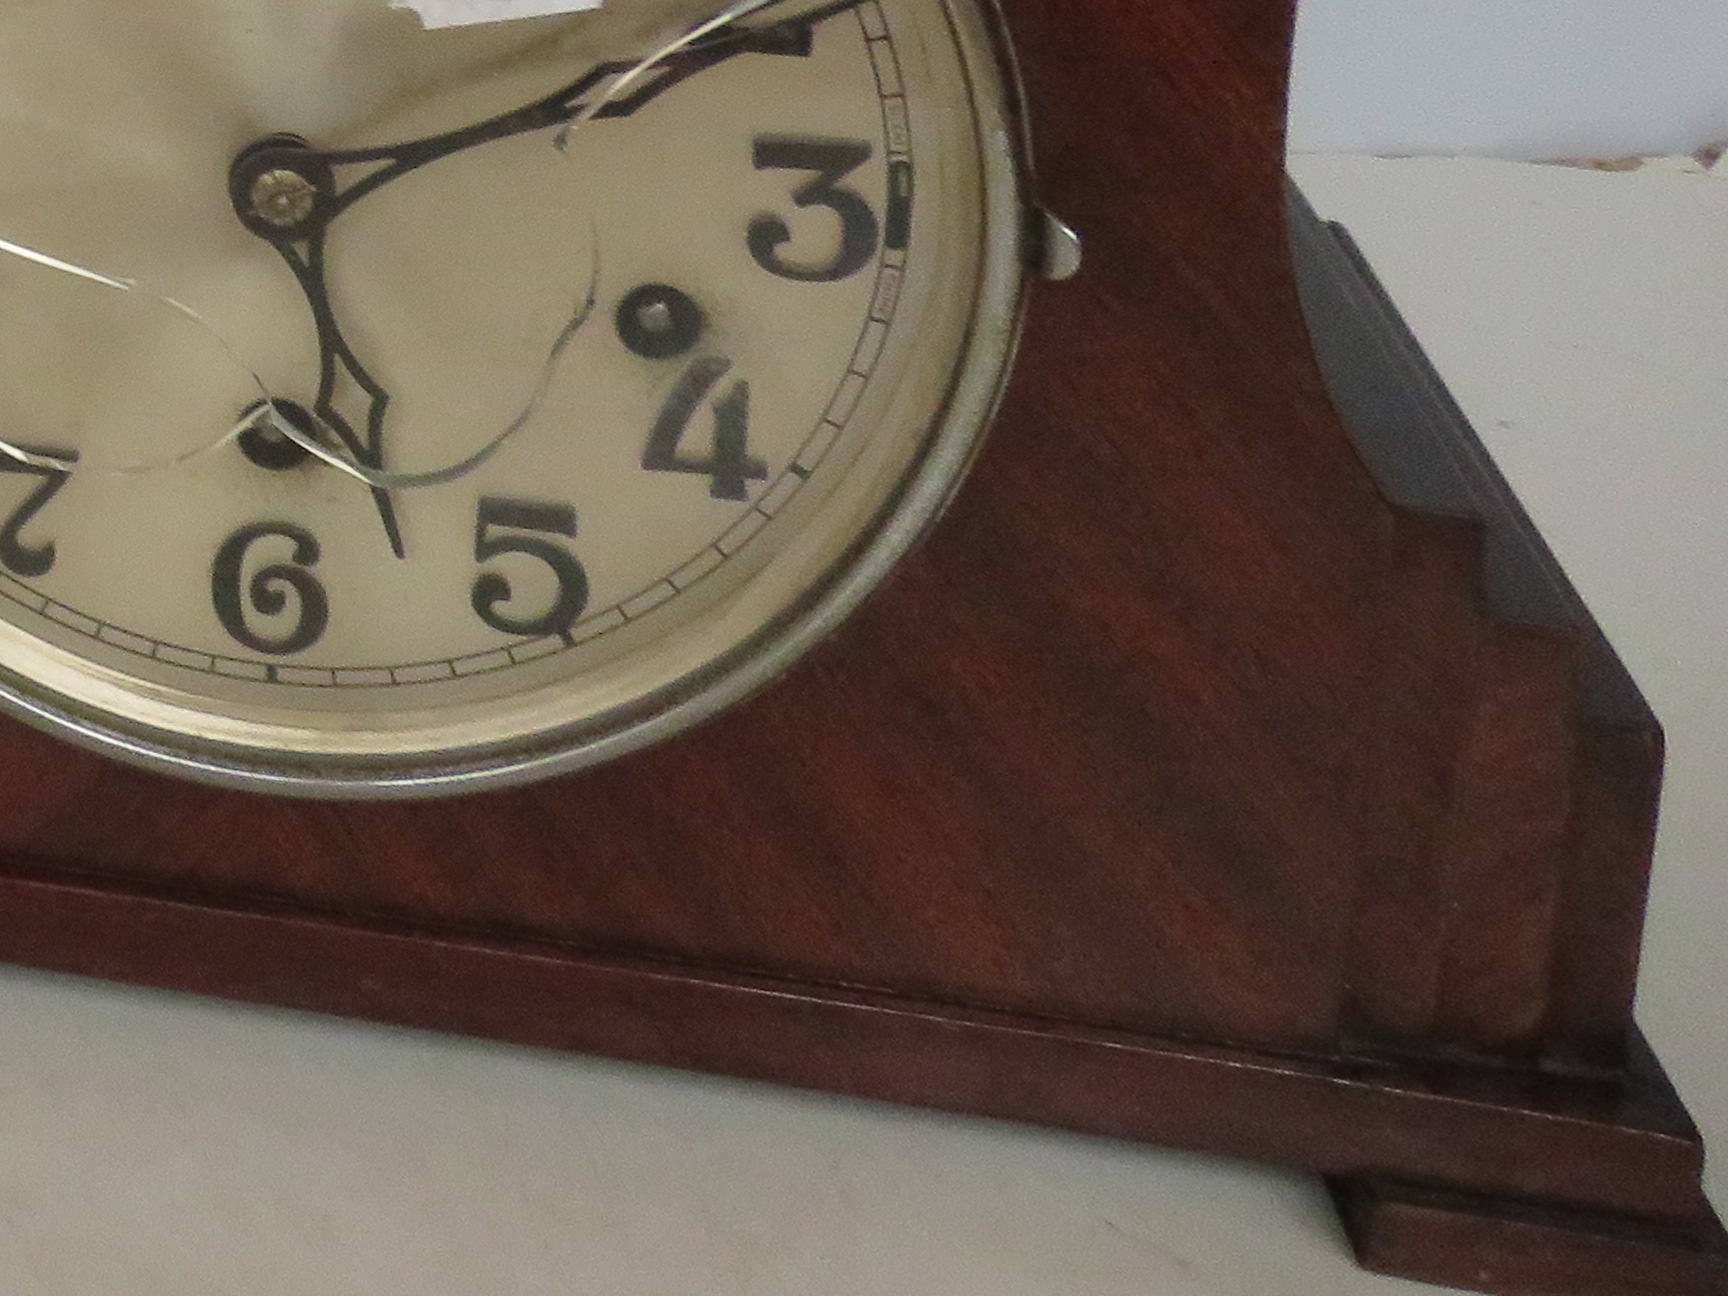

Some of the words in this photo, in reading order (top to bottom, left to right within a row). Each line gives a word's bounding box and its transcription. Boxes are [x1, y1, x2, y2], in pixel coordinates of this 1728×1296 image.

[745, 134, 882, 283] 3
[639, 356, 771, 503] 4
[211, 520, 330, 656] 6
[470, 497, 592, 640] 5
